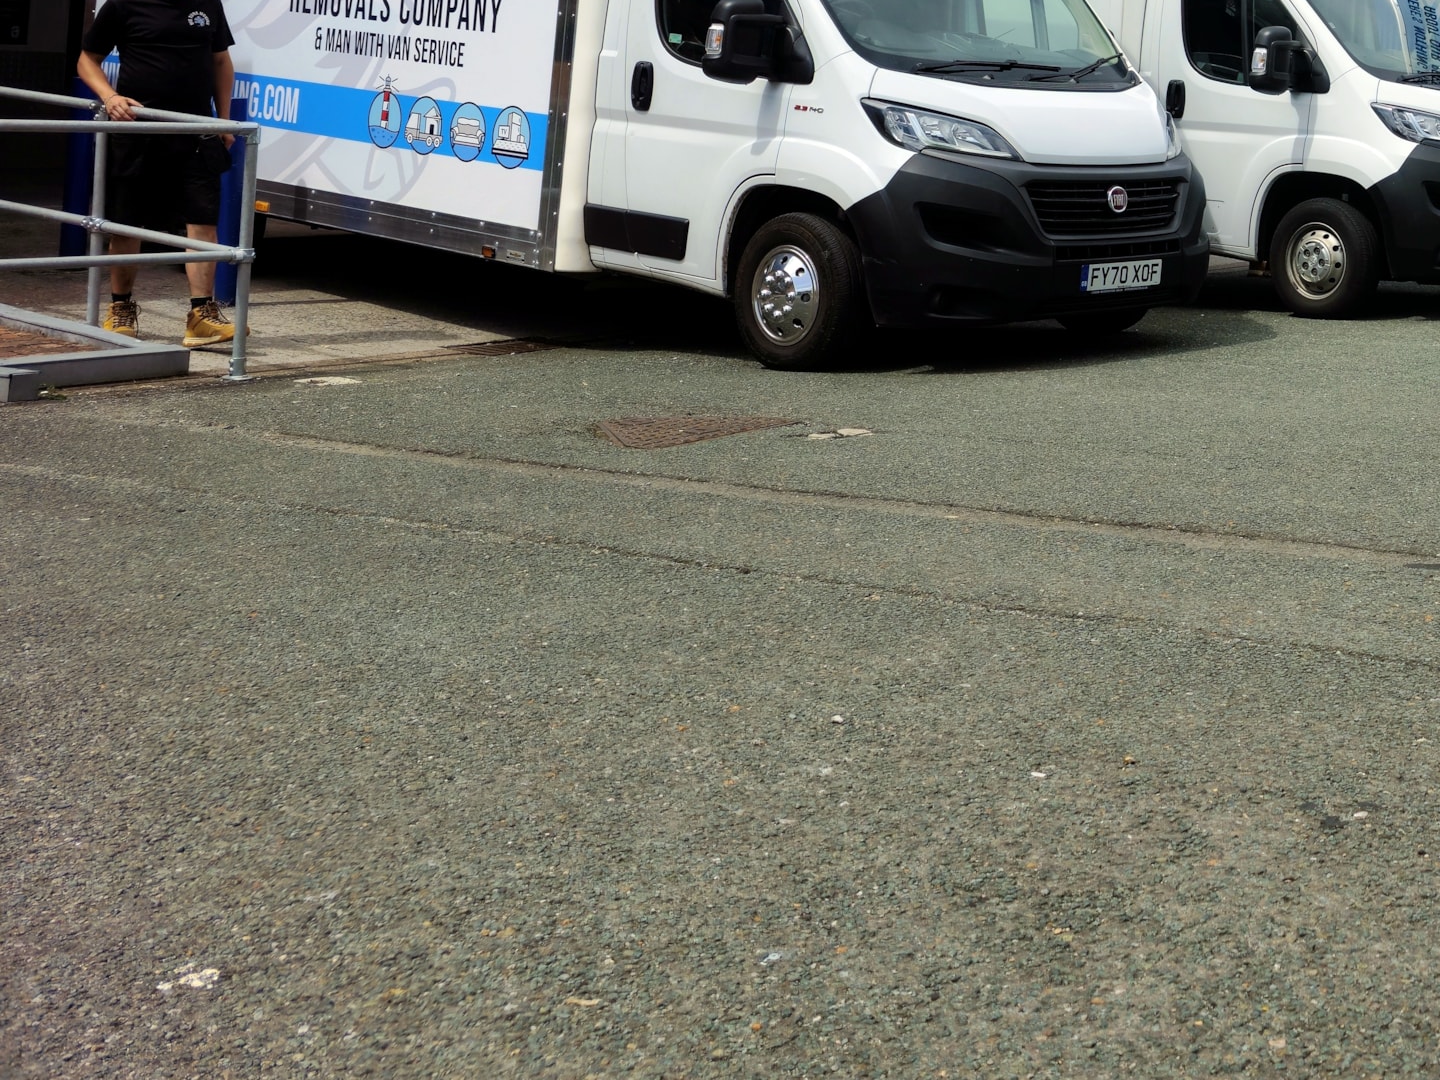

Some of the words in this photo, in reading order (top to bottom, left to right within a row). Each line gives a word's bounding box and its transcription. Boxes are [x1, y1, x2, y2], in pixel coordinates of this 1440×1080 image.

[314, 27, 322, 50] &
[325, 27, 351, 54] MAN
[354, 30, 384, 58] WITH
[387, 35, 411, 61] VAN
[413, 37, 466, 68] SERVICE
[501, 128, 508, 136] TV
[1091, 265, 1128, 287] FY70
[1132, 264, 1159, 283] XOF
